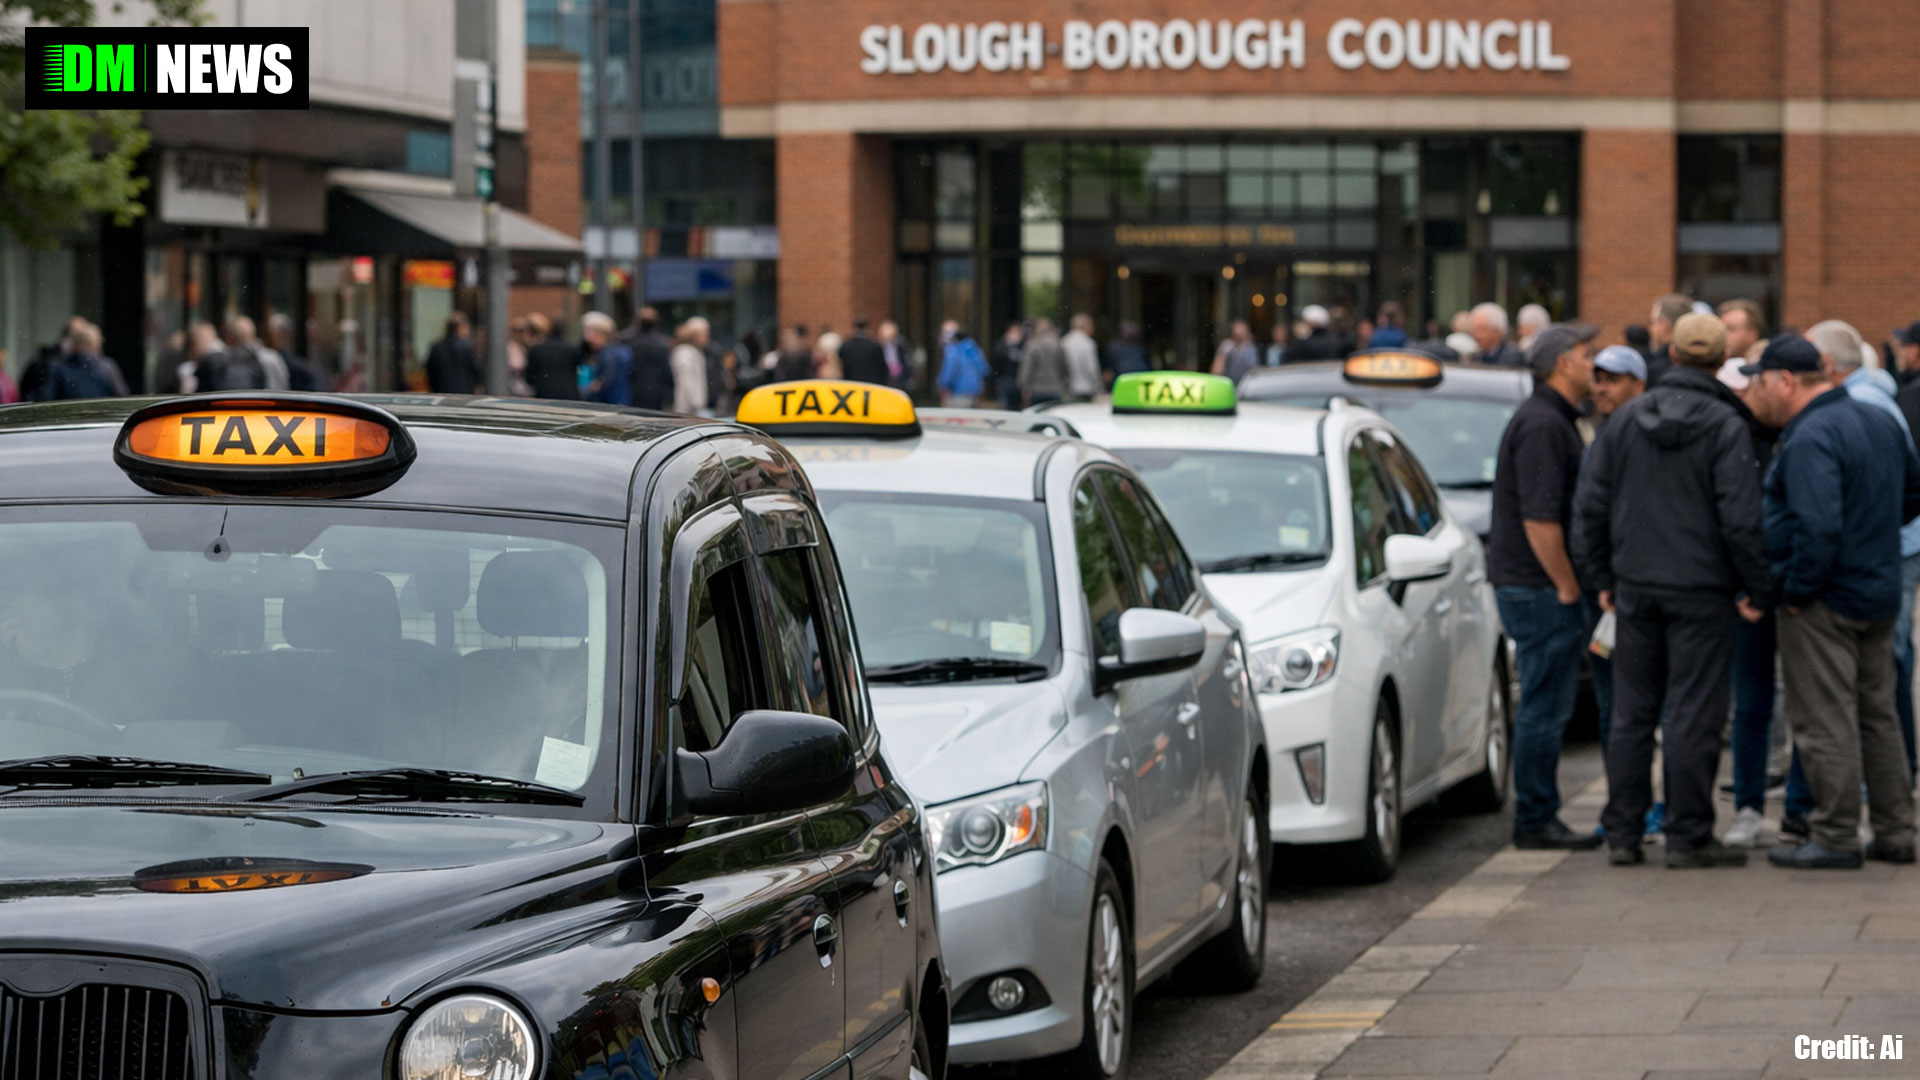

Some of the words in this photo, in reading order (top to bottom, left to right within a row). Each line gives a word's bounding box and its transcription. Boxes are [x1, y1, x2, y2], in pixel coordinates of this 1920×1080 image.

[860, 21, 1044, 75] SLOUGH
[1063, 19, 1305, 71] BOROUGH
[1327, 18, 1571, 71] COUNCIL
[774, 389, 871, 417] TAXI
[1142, 381, 1206, 404] TAXI
[181, 416, 327, 457] TAXI
